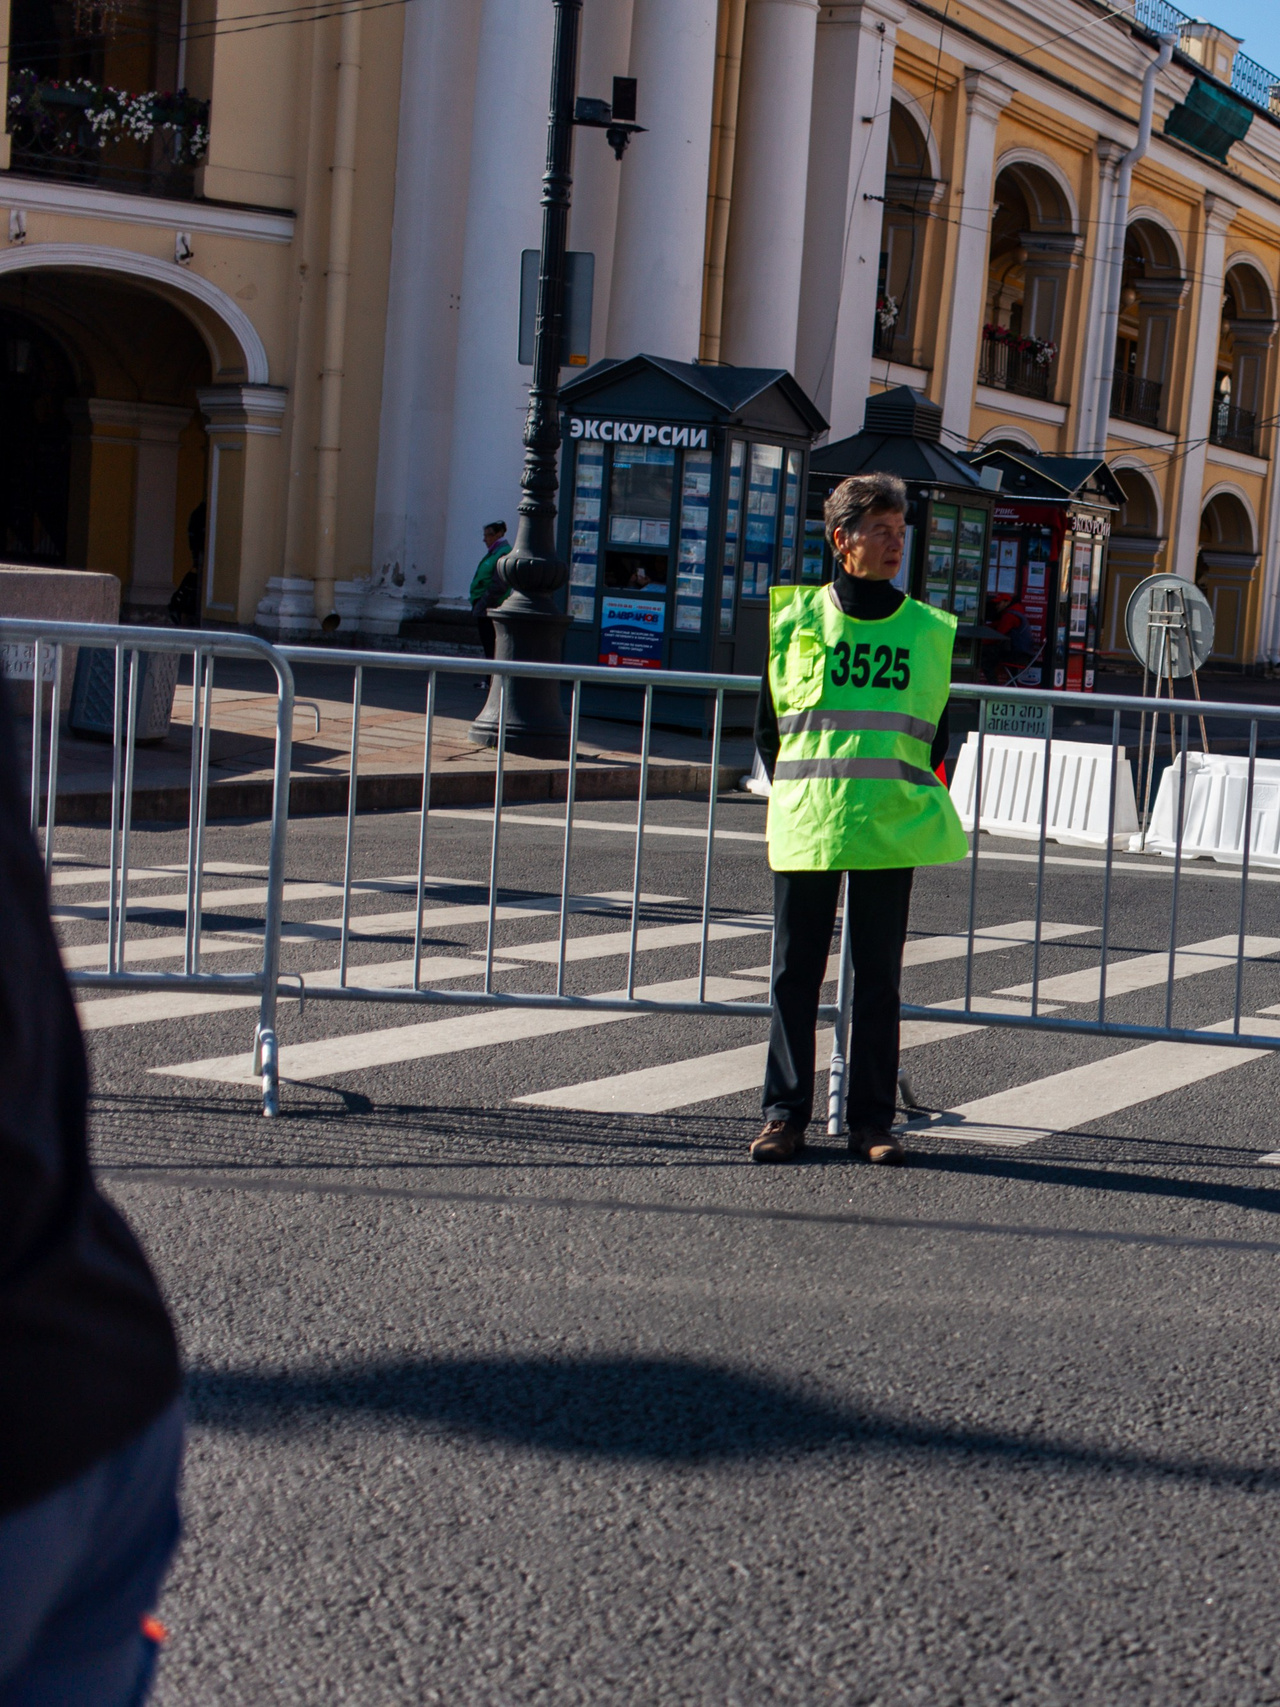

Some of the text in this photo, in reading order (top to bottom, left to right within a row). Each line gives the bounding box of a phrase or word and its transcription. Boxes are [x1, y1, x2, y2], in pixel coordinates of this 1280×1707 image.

[570, 418, 707, 448] ЭКСКУРСИИ
[1071, 517, 1111, 537] ЭКСКУРСИИ
[831, 641, 910, 691] 3525
